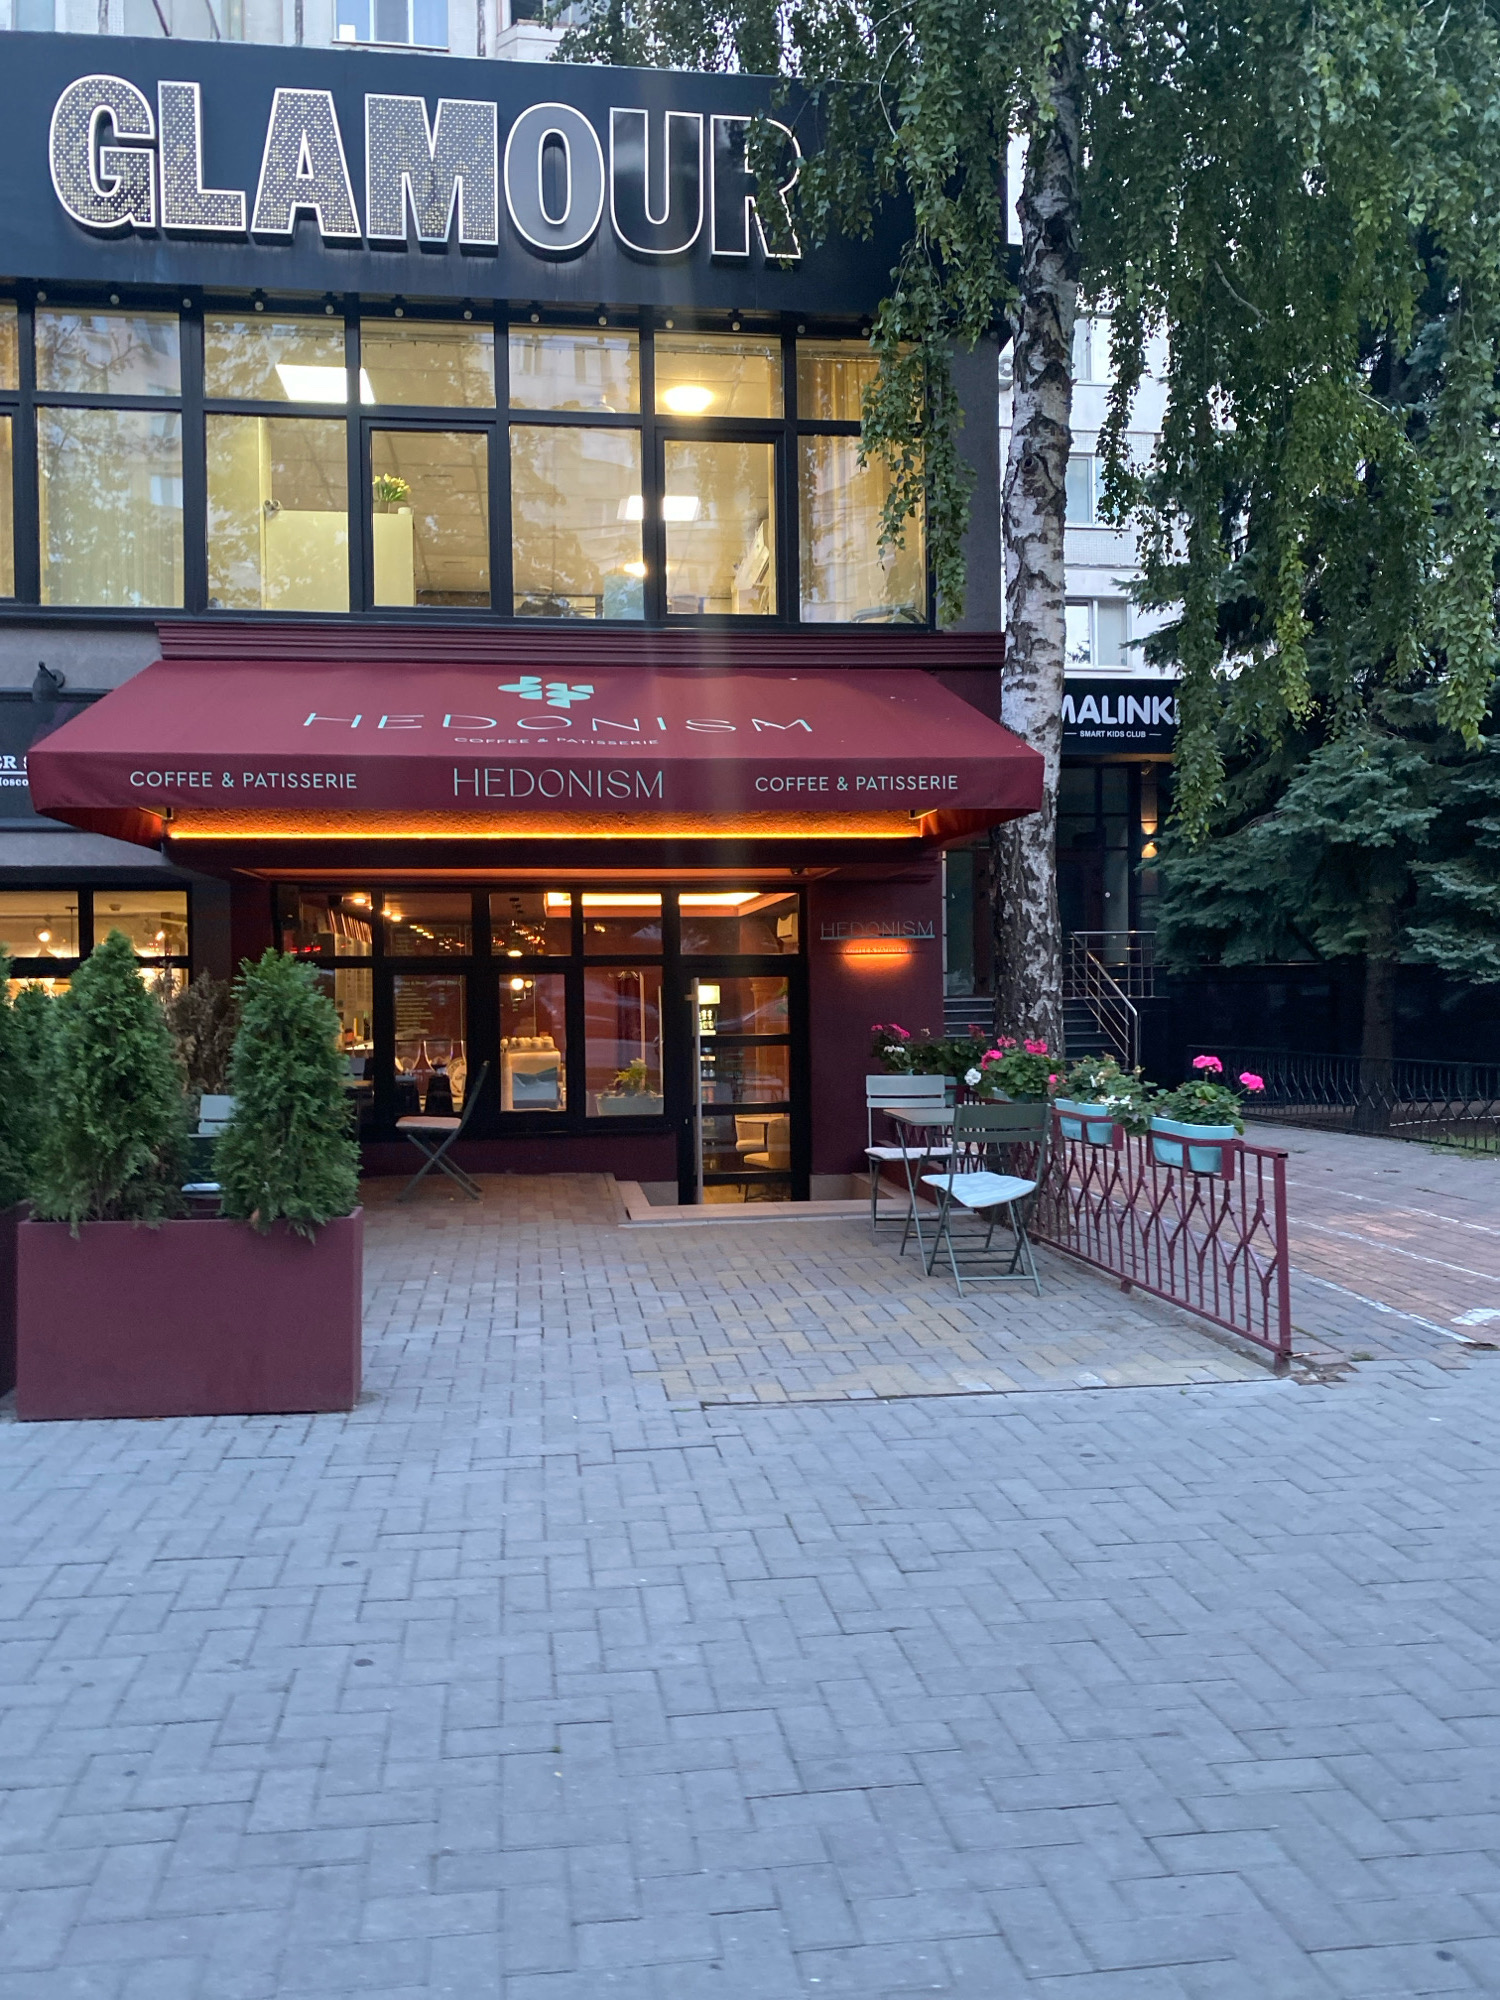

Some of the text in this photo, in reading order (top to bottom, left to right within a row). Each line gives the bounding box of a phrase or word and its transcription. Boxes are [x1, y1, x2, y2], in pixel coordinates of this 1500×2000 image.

[48, 73, 802, 260] GLAMOUR
[303, 712, 813, 732] HEDONISM
[556, 737, 659, 745] PATISSERIE
[1079, 730, 1105, 738] SMART
[1106, 730, 1125, 738] KIDS
[129, 770, 358, 790] COFFEE & PATISSERIE
[453, 767, 664, 799] HEDONISM
[754, 775, 959, 793] COFFEE & PATISSERIE
[820, 920, 934, 938] HEDONISM
